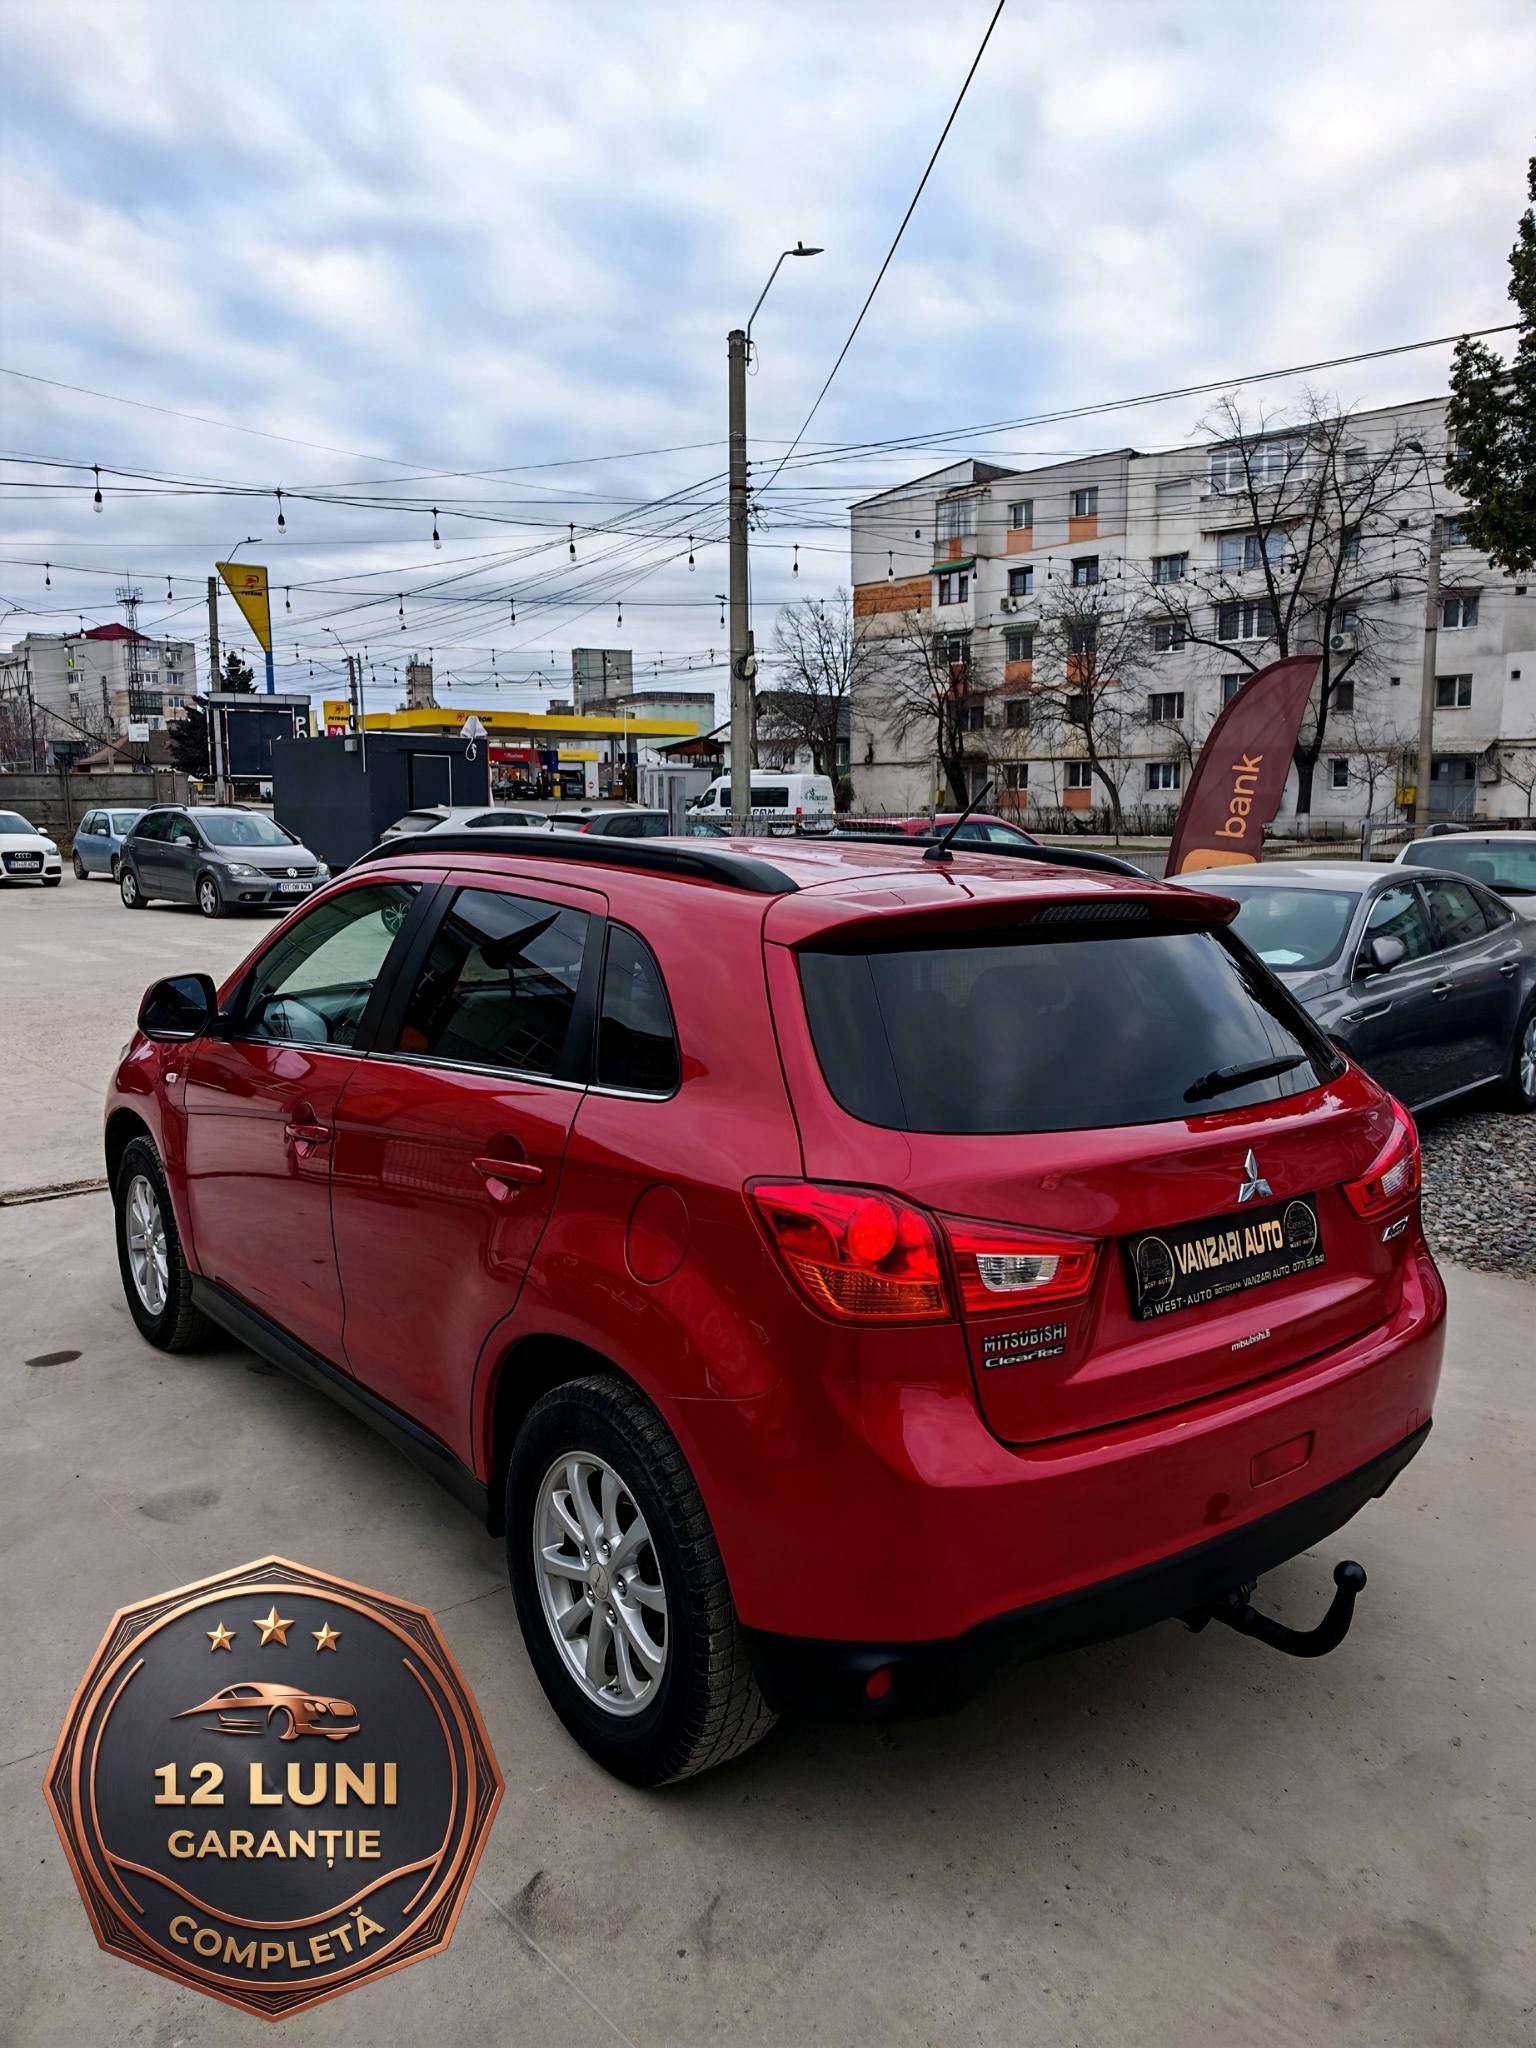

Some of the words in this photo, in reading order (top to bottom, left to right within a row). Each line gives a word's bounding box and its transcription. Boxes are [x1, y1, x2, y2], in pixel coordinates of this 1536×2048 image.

[1215, 753, 1264, 839] bank
[1174, 1230, 1244, 1275] VANZARI
[1245, 1220, 1284, 1258] AUTO
[1154, 1289, 1213, 1315] WEST-AUTO
[1214, 1282, 1242, 1295] BOTOSANI
[1243, 1270, 1272, 1287] VANZARI
[1272, 1265, 1290, 1279] AUTO
[984, 1323, 1068, 1353] MITSUBISHI
[985, 1346, 1064, 1368] ClearTec
